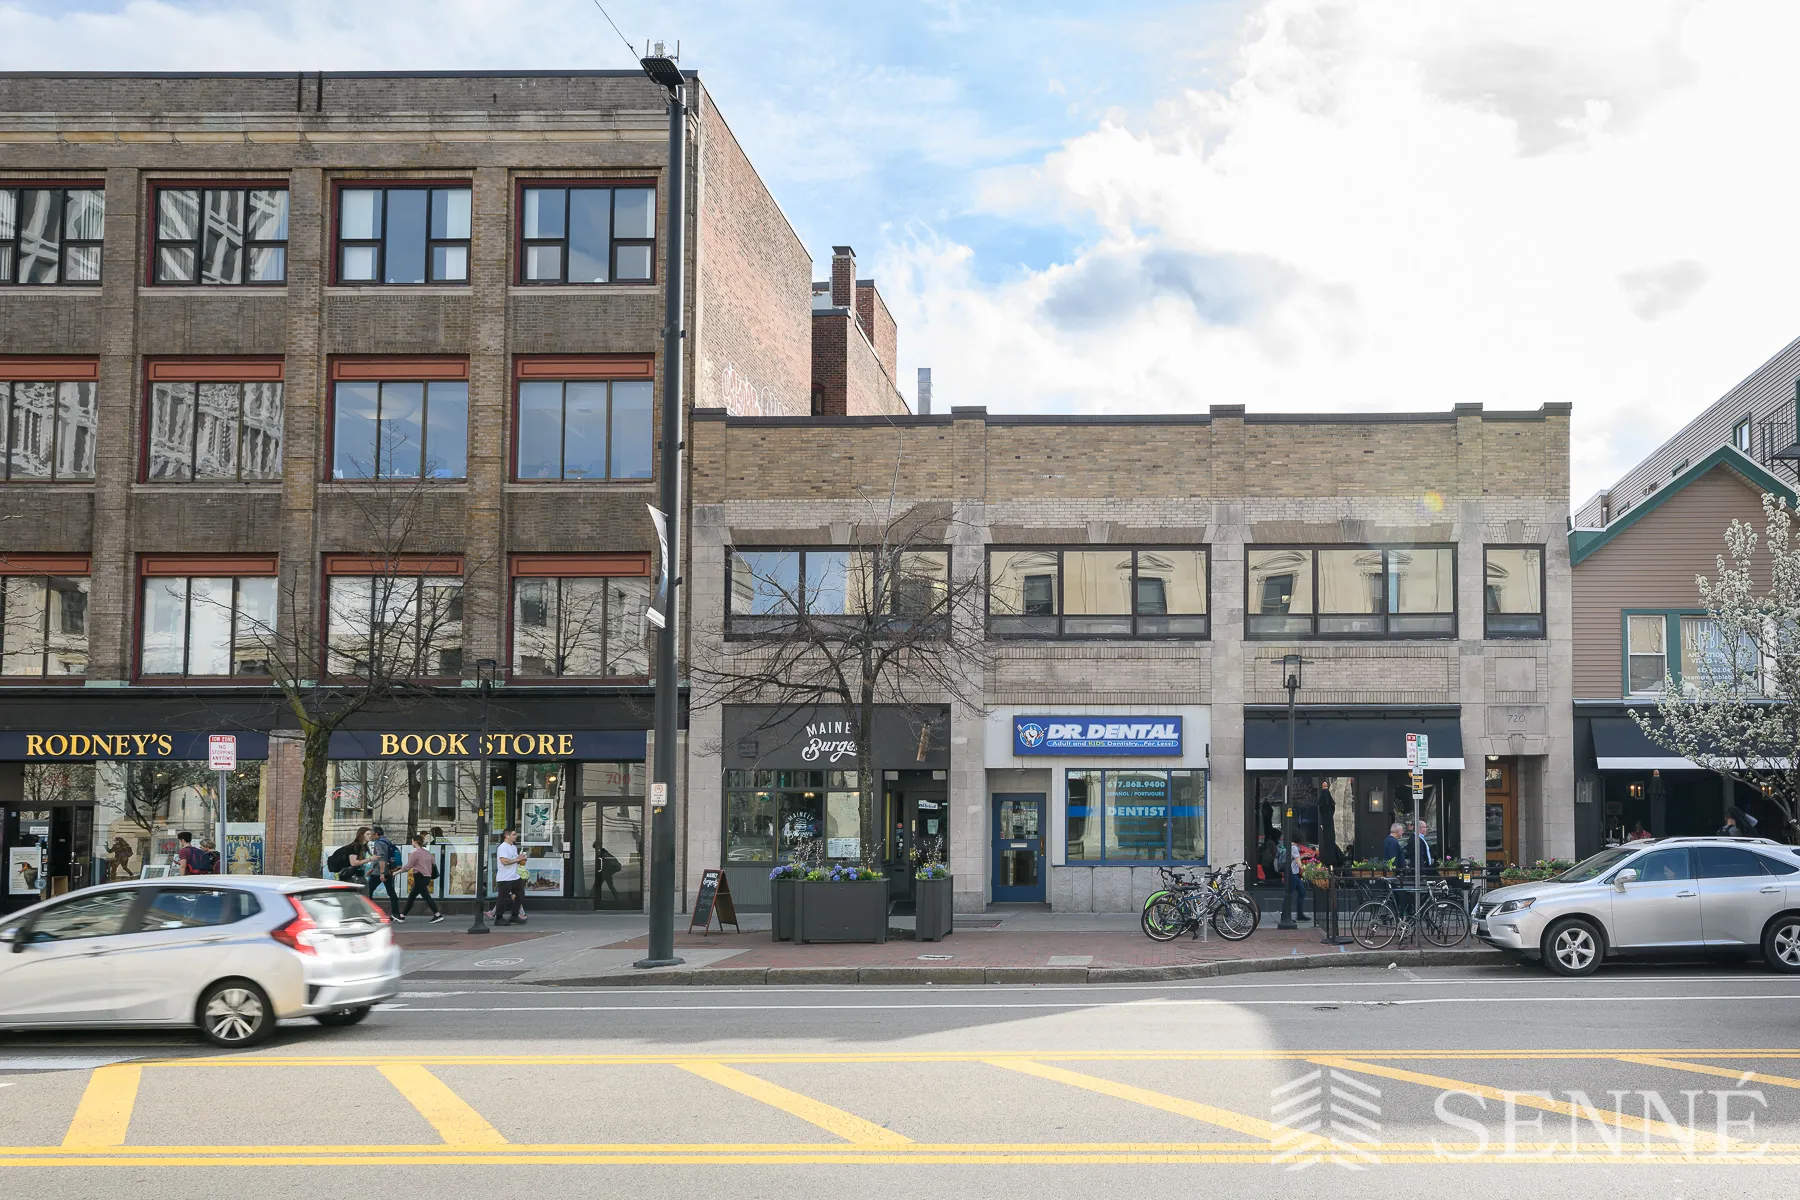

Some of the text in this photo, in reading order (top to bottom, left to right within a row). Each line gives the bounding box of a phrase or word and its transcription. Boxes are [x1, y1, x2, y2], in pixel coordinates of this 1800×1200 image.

[1508, 714, 1526, 723] 720
[805, 721, 852, 738] MAINE
[26, 733, 173, 756] RODNEY'S
[380, 733, 575, 756] BOOK STORE
[801, 737, 858, 763] Burge
[605, 773, 631, 785] 700
[1107, 806, 1166, 816] DENTIST
